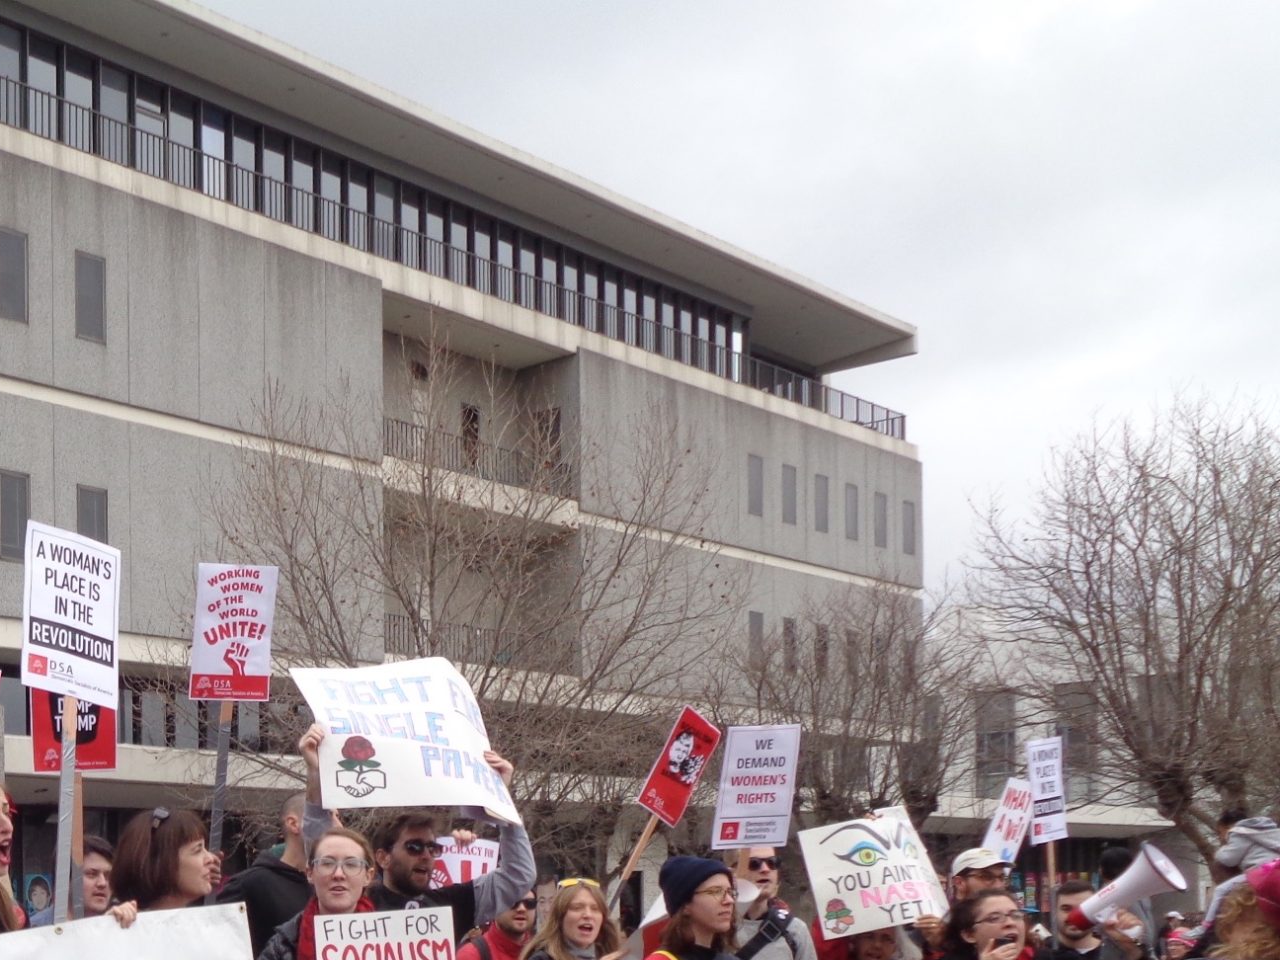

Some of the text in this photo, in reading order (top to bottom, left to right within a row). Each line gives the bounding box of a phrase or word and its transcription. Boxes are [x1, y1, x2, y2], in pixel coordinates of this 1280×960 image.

[36, 540, 112, 580] A WOMAN'S
[44, 567, 100, 602] PLACE IS
[207, 569, 260, 587] WORKING
[221, 582, 263, 594] WOMEN
[54, 595, 93, 626] IN THE
[208, 595, 243, 612] OF THE
[219, 608, 258, 620] WORLD
[31, 622, 112, 663] REVOLUTION
[203, 621, 266, 645] UNITE!
[49, 660, 73, 675] DSA
[320, 675, 431, 704] FIGHT
[324, 707, 449, 746] SINGLE
[755, 739, 774, 750] WE
[737, 756, 786, 769] DEMAND
[731, 774, 787, 786] WOMEN'S
[736, 793, 776, 804] RIGHTS
[828, 871, 871, 894] YOU
[323, 914, 440, 941] FIGHT FOR
